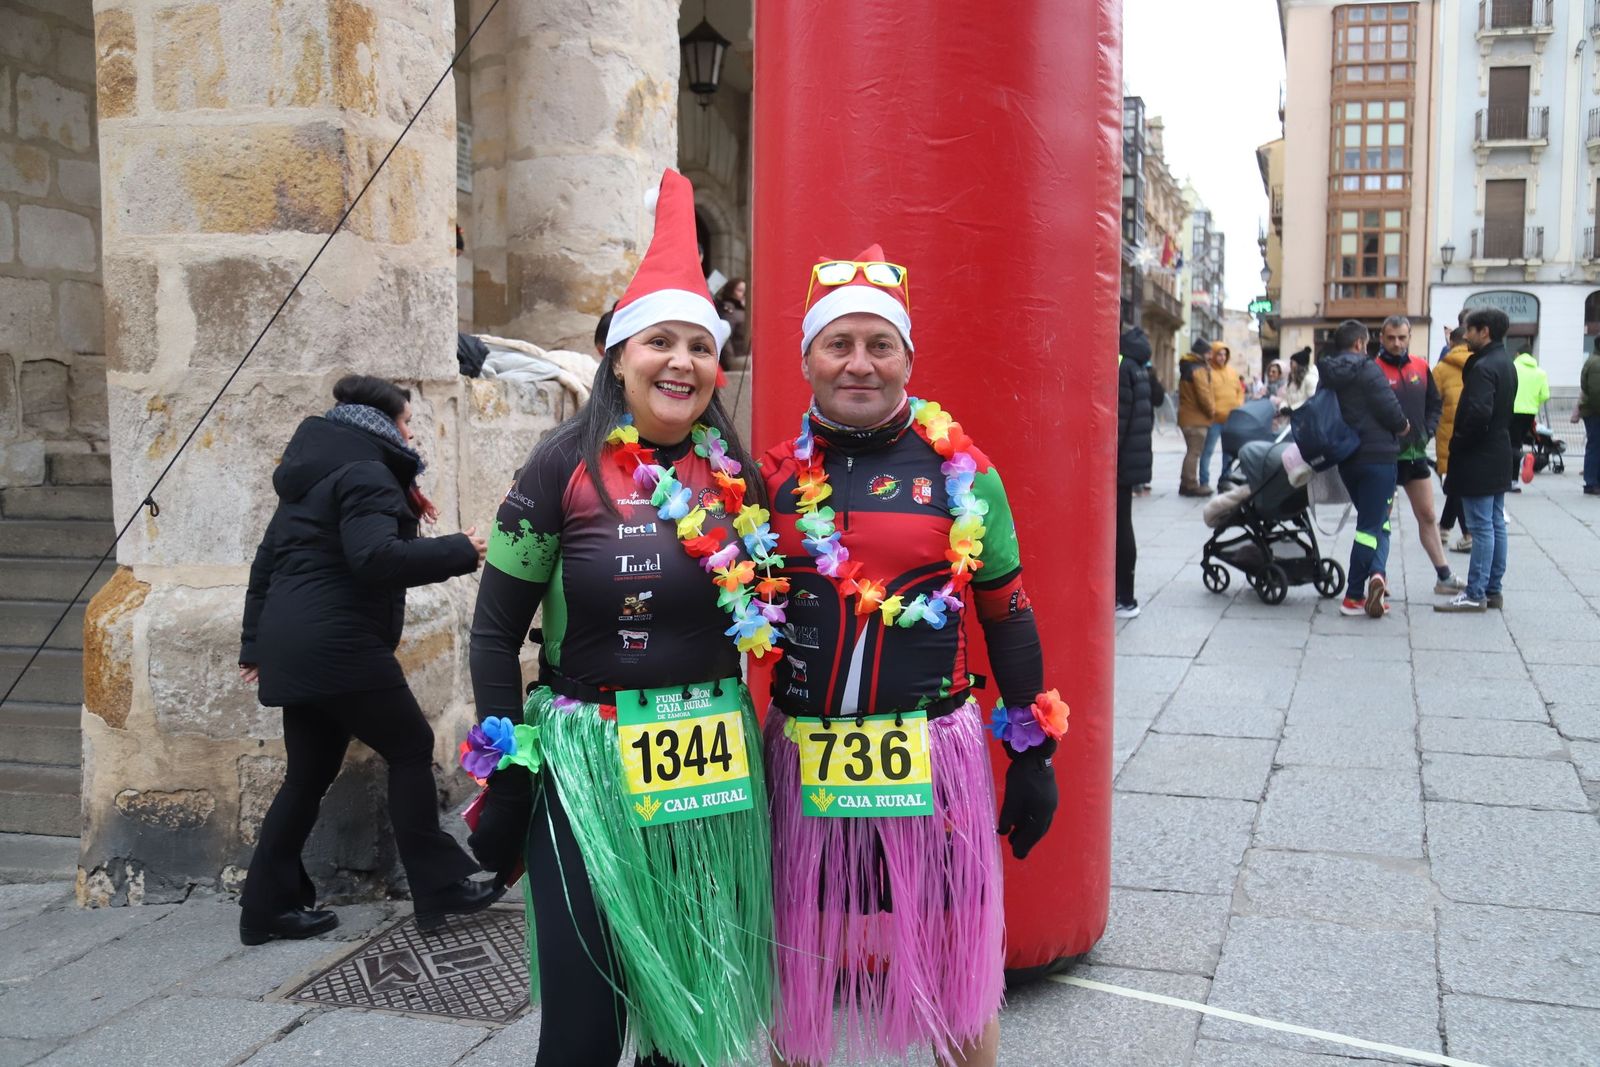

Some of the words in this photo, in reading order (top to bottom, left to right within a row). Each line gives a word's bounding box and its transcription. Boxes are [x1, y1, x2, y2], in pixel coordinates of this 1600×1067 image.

[615, 553, 661, 573] Turiel
[656, 702, 681, 713] CAJA
[684, 699, 712, 711] RURAL
[667, 711, 691, 719] ZAMORA
[632, 721, 732, 783] 1344
[809, 730, 911, 781] 736
[664, 797, 699, 813] CAJA
[702, 788, 748, 807] RURAL
[837, 795, 872, 808] CAJA
[876, 793, 927, 807] RURAL
